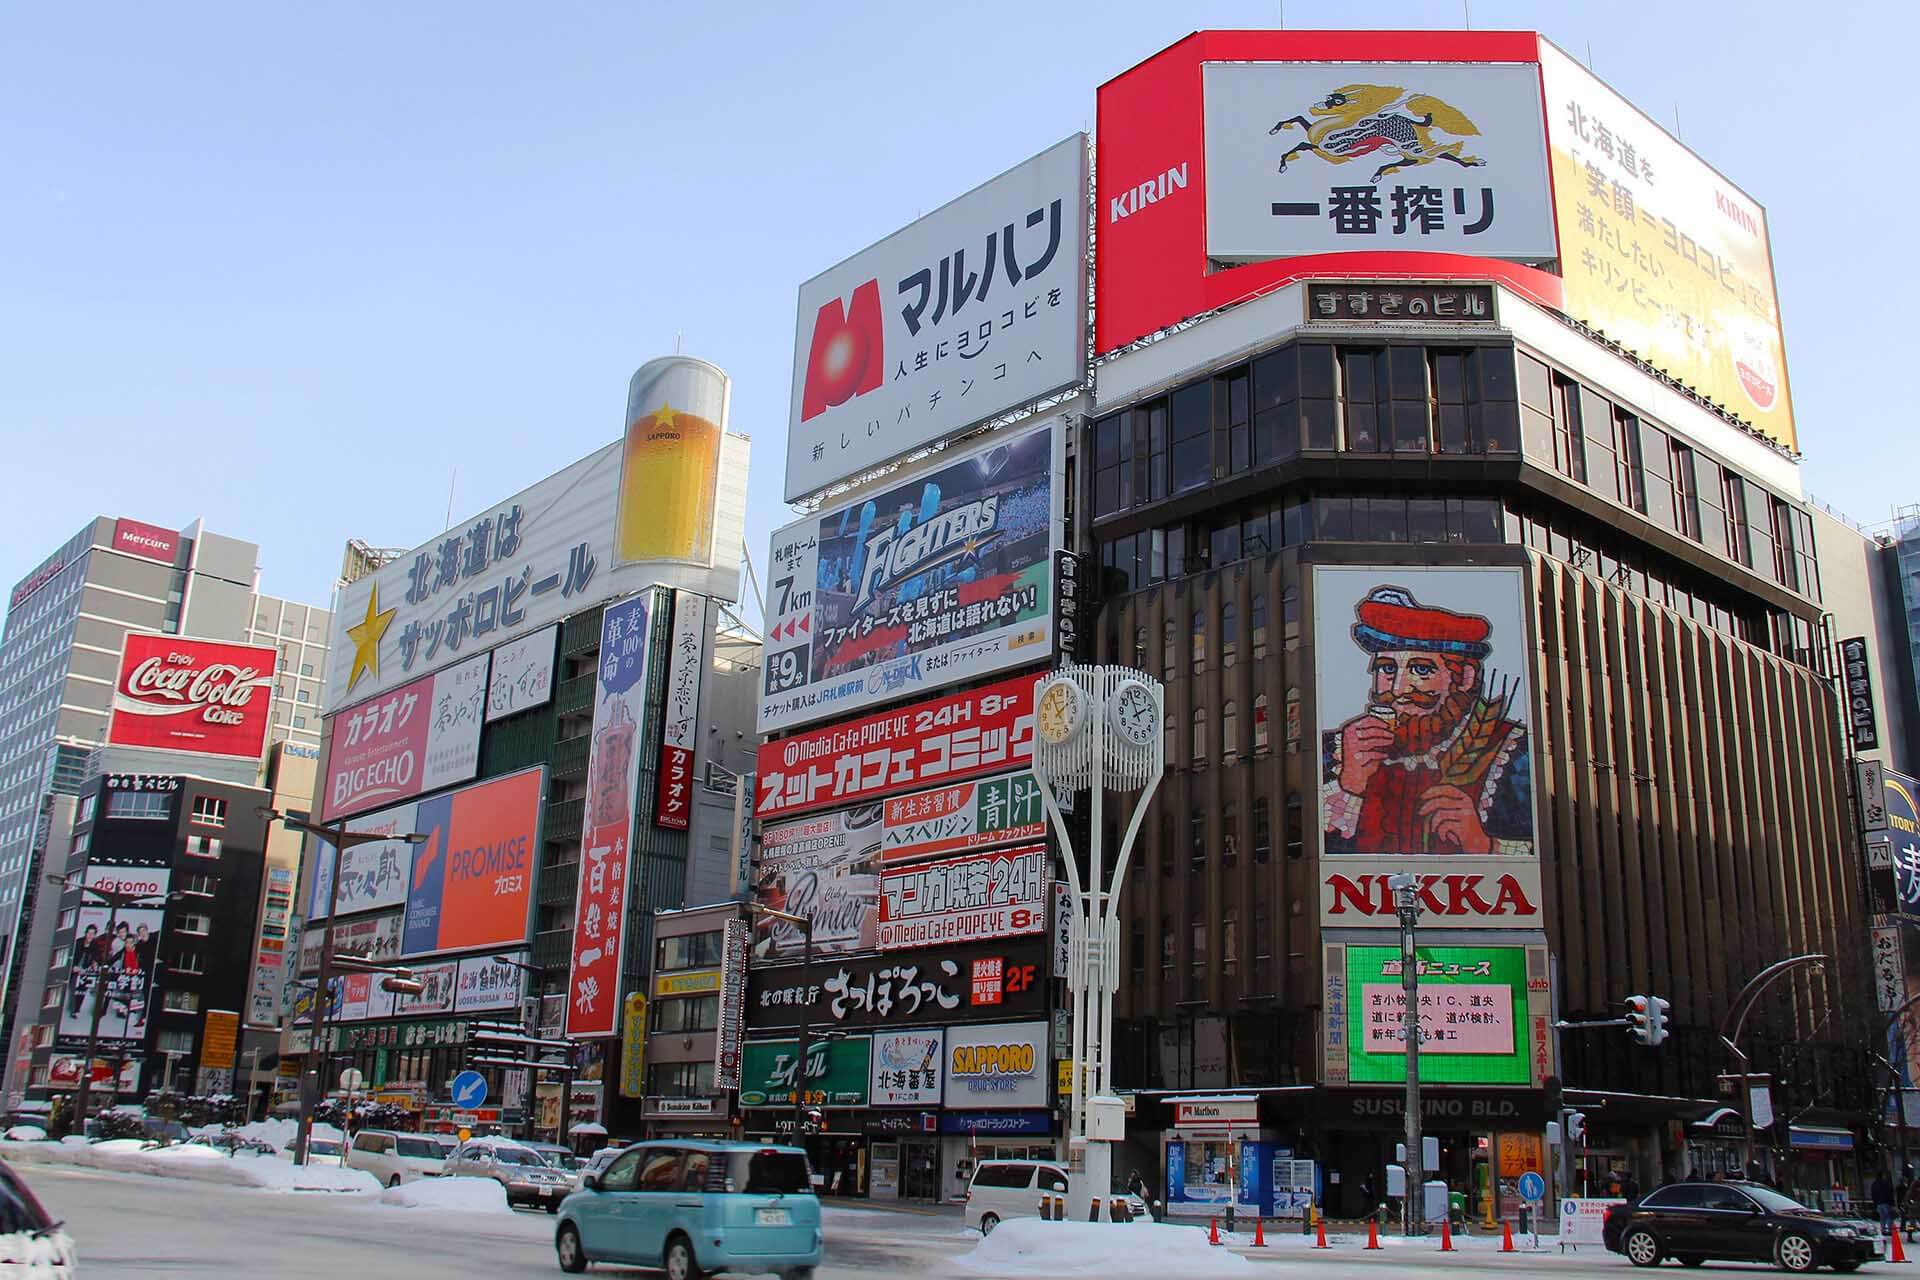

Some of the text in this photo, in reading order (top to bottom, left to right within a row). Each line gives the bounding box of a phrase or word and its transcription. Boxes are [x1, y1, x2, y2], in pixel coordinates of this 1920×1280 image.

[1566, 101, 1655, 186] 北海道を
[1110, 162, 1188, 224] KIRIN
[1271, 185, 1495, 235] 一番搾り
[1714, 189, 1758, 239] KIRIN
[898, 198, 1062, 336] マルハン
[1316, 291, 1486, 316] すすきのビル
[894, 288, 1062, 382] 人生にヨロコビを
[810, 349, 1042, 463] 新しいパチンコへ
[646, 431, 681, 442] SAPPORO
[122, 530, 170, 551] Mercure
[405, 504, 523, 605] 北海道は
[775, 535, 817, 563] 札幌ドーム
[851, 495, 1000, 615] FIGHTERS
[787, 556, 802, 572] まで
[400, 542, 598, 672] サッポロビール
[823, 588, 958, 648] ファイターズを見ずに
[167, 652, 195, 665] Enjoy
[603, 618, 624, 682] 革命
[926, 653, 948, 671] または
[203, 705, 244, 726] Coke
[344, 692, 418, 748] カラオケ
[914, 701, 971, 733] 24H
[979, 694, 1018, 716] 8F
[333, 766, 366, 808] BIG
[366, 750, 414, 787] ECHO
[667, 749, 687, 813] カラオケ
[757, 747, 916, 813] ネットカフェ
[890, 789, 961, 821] 新生活習慣
[981, 780, 1040, 829] 青汁
[886, 814, 973, 844] ヘスペリジン
[967, 824, 1041, 846] ドリーム ファクトリー
[450, 835, 528, 883] PROMISE
[94, 877, 158, 895] docomo
[494, 875, 523, 896] プロミス
[1325, 873, 1537, 917] NIKKA
[956, 911, 1005, 936] POPEYE
[1010, 908, 1042, 929] 8F
[824, 959, 960, 1020] さっぽろっこ
[1006, 965, 1035, 993] 2F
[1527, 978, 1549, 989] uhb
[1327, 975, 1344, 1045] 北海道新聞
[878, 1069, 936, 1090] 北海番屋
[952, 1043, 1034, 1075] SAPPORO
[1193, 1105, 1220, 1116] Marlboro
[1353, 1099, 1520, 1116] SUSUINO BLD.
